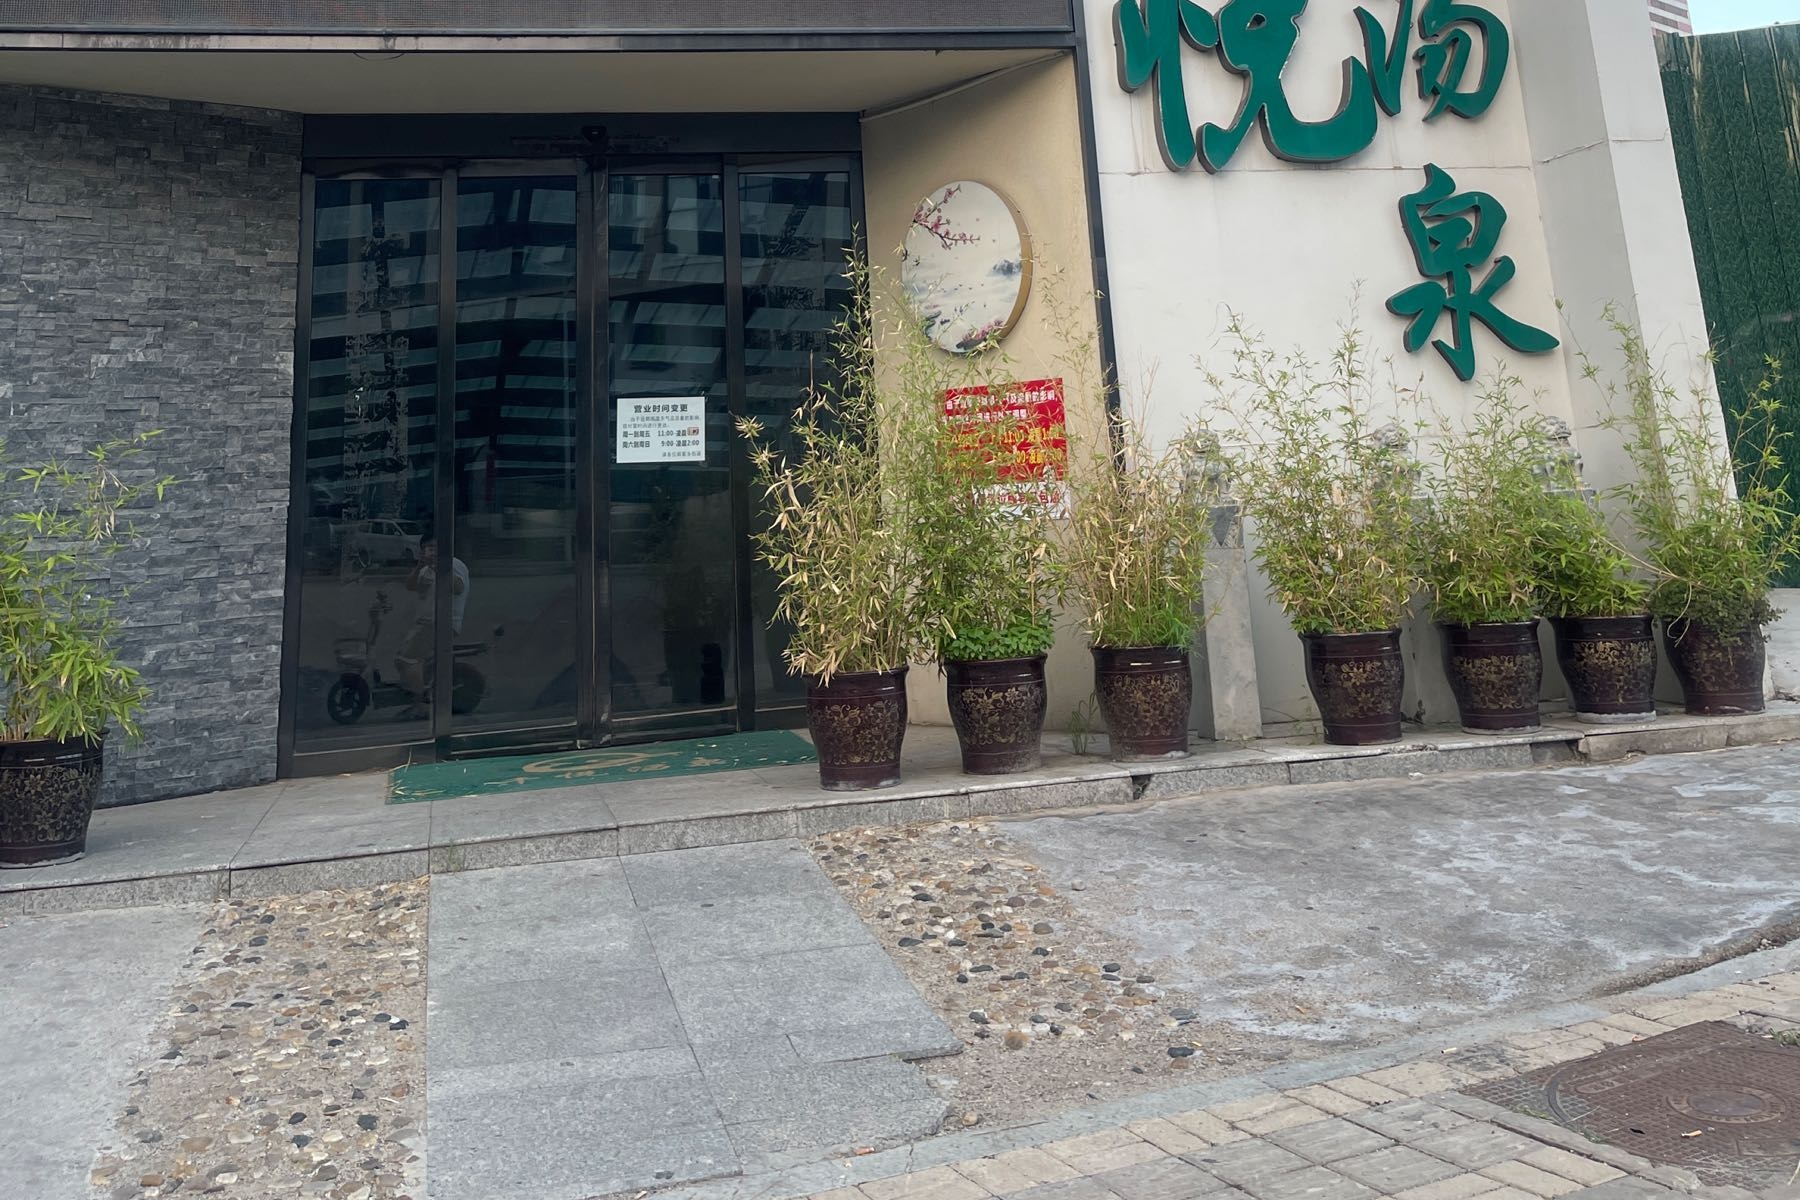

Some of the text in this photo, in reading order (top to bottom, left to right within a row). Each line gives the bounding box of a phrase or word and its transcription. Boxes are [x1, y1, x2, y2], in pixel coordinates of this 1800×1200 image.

[634, 403, 688, 413] 营业时间变更
[622, 430, 650, 438] 周一到周五
[622, 440, 650, 448] 周六到周日
